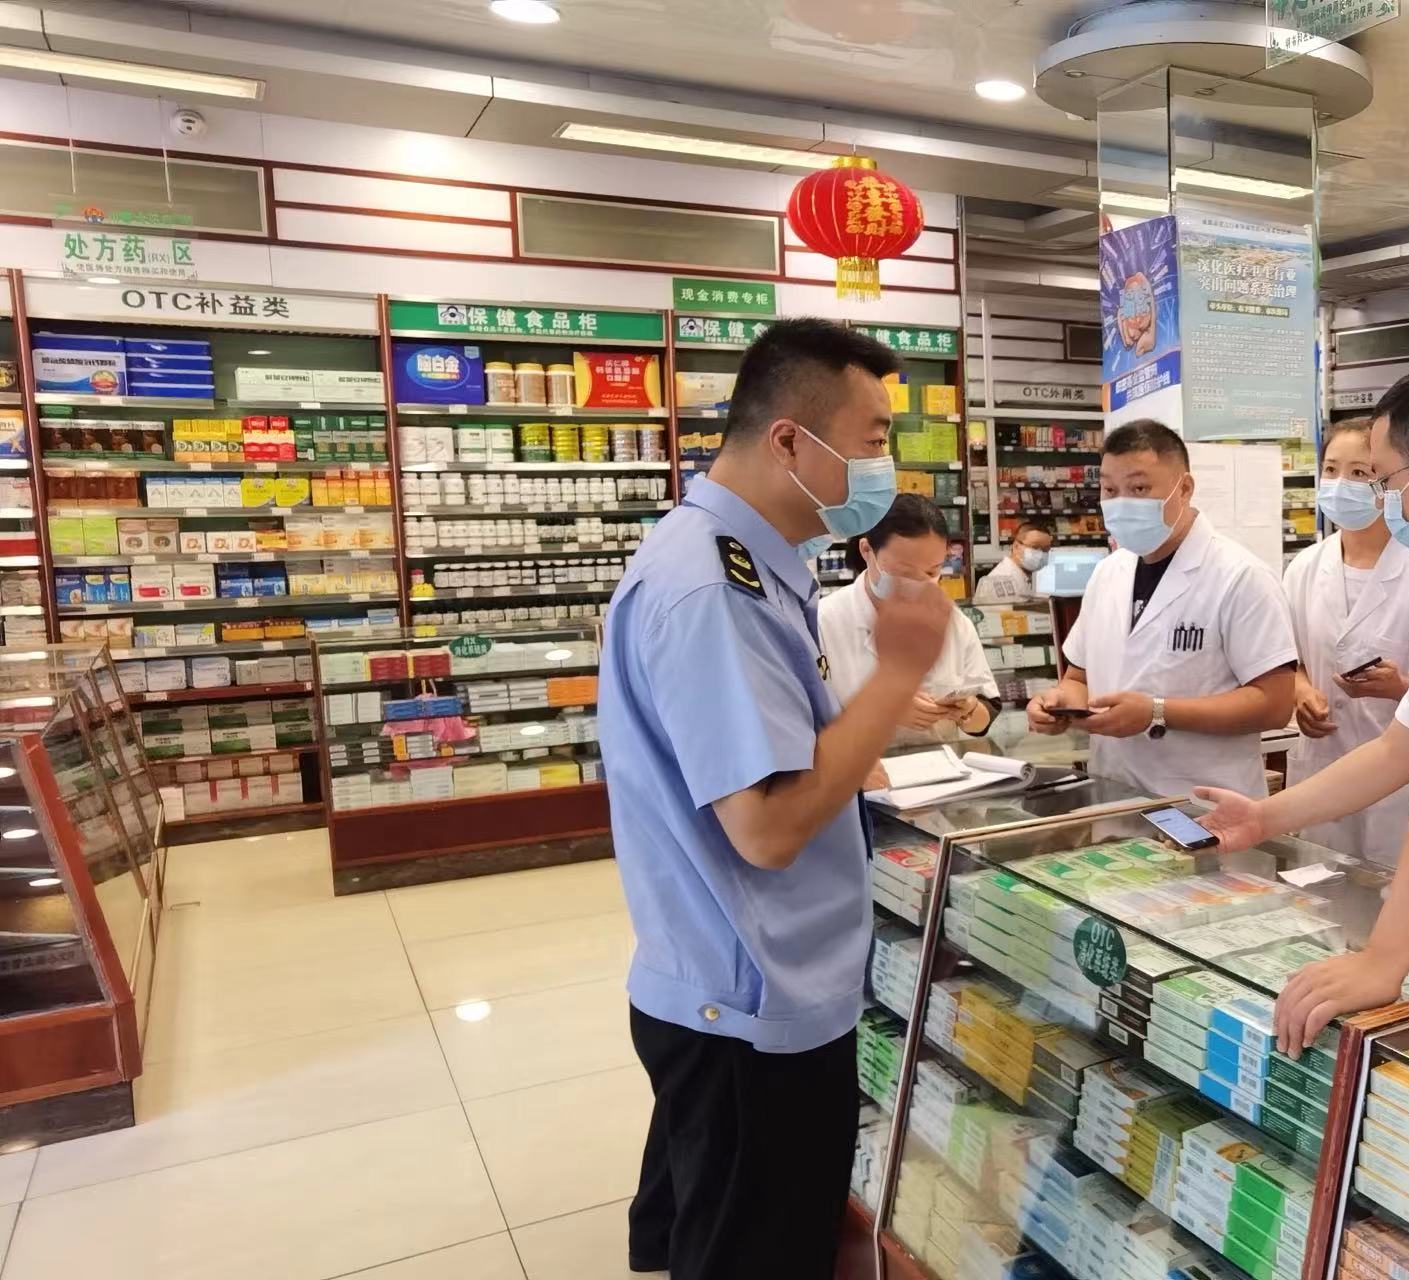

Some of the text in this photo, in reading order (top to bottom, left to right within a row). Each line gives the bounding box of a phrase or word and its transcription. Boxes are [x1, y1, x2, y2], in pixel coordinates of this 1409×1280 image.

[121, 288, 290, 320] OTC补益类
[680, 288, 769, 306] 现金消费专柜
[467, 306, 597, 331] 保健食品柜
[1091, 922, 1115, 951] OTC
